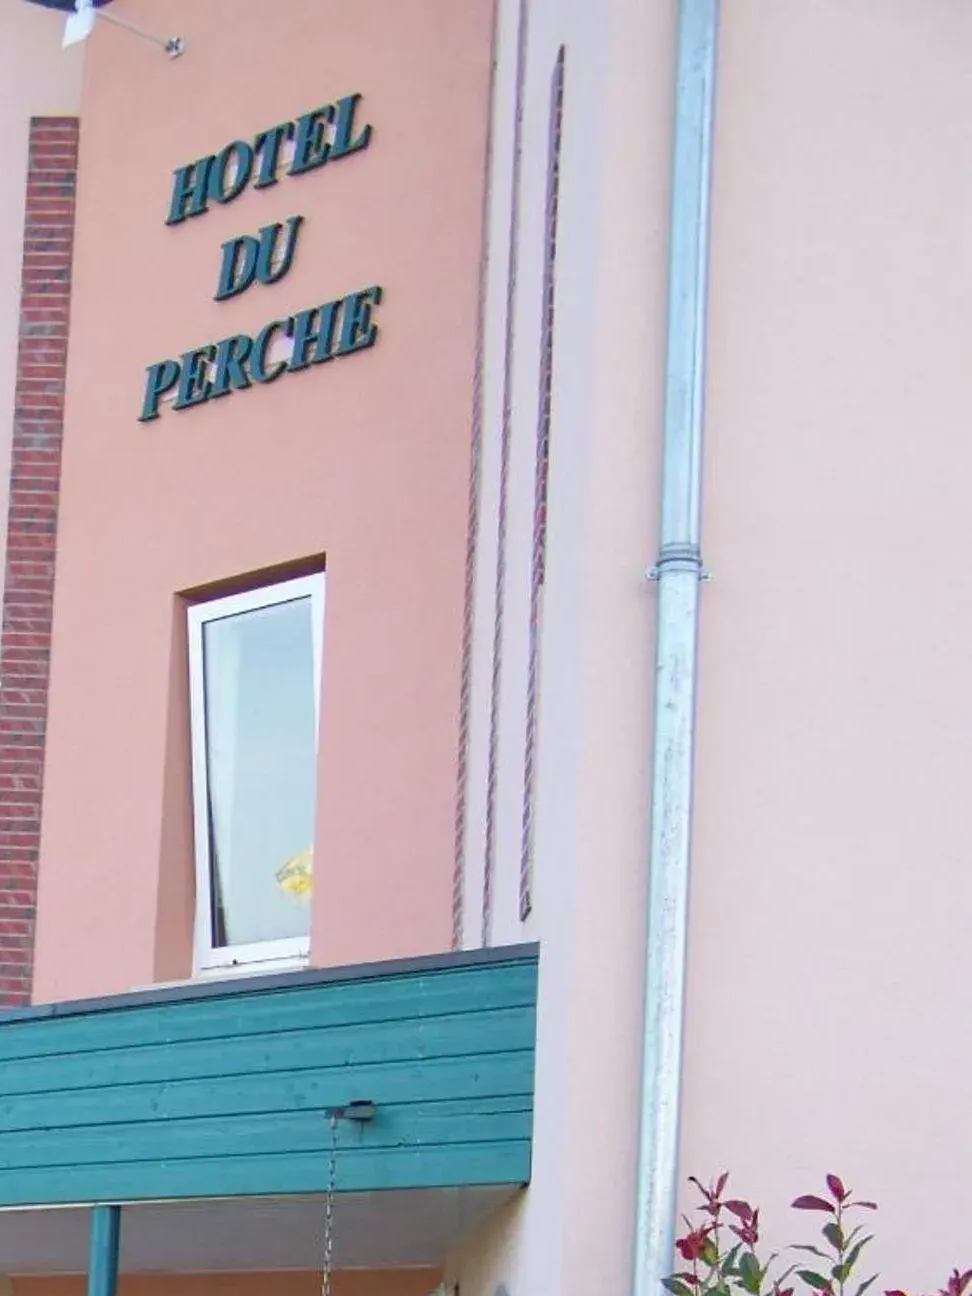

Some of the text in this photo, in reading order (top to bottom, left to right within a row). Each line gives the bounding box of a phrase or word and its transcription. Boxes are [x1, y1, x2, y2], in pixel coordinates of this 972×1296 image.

[165, 92, 373, 226] HOTEL
[213, 215, 304, 302] DU
[137, 285, 383, 422] PERCHE
